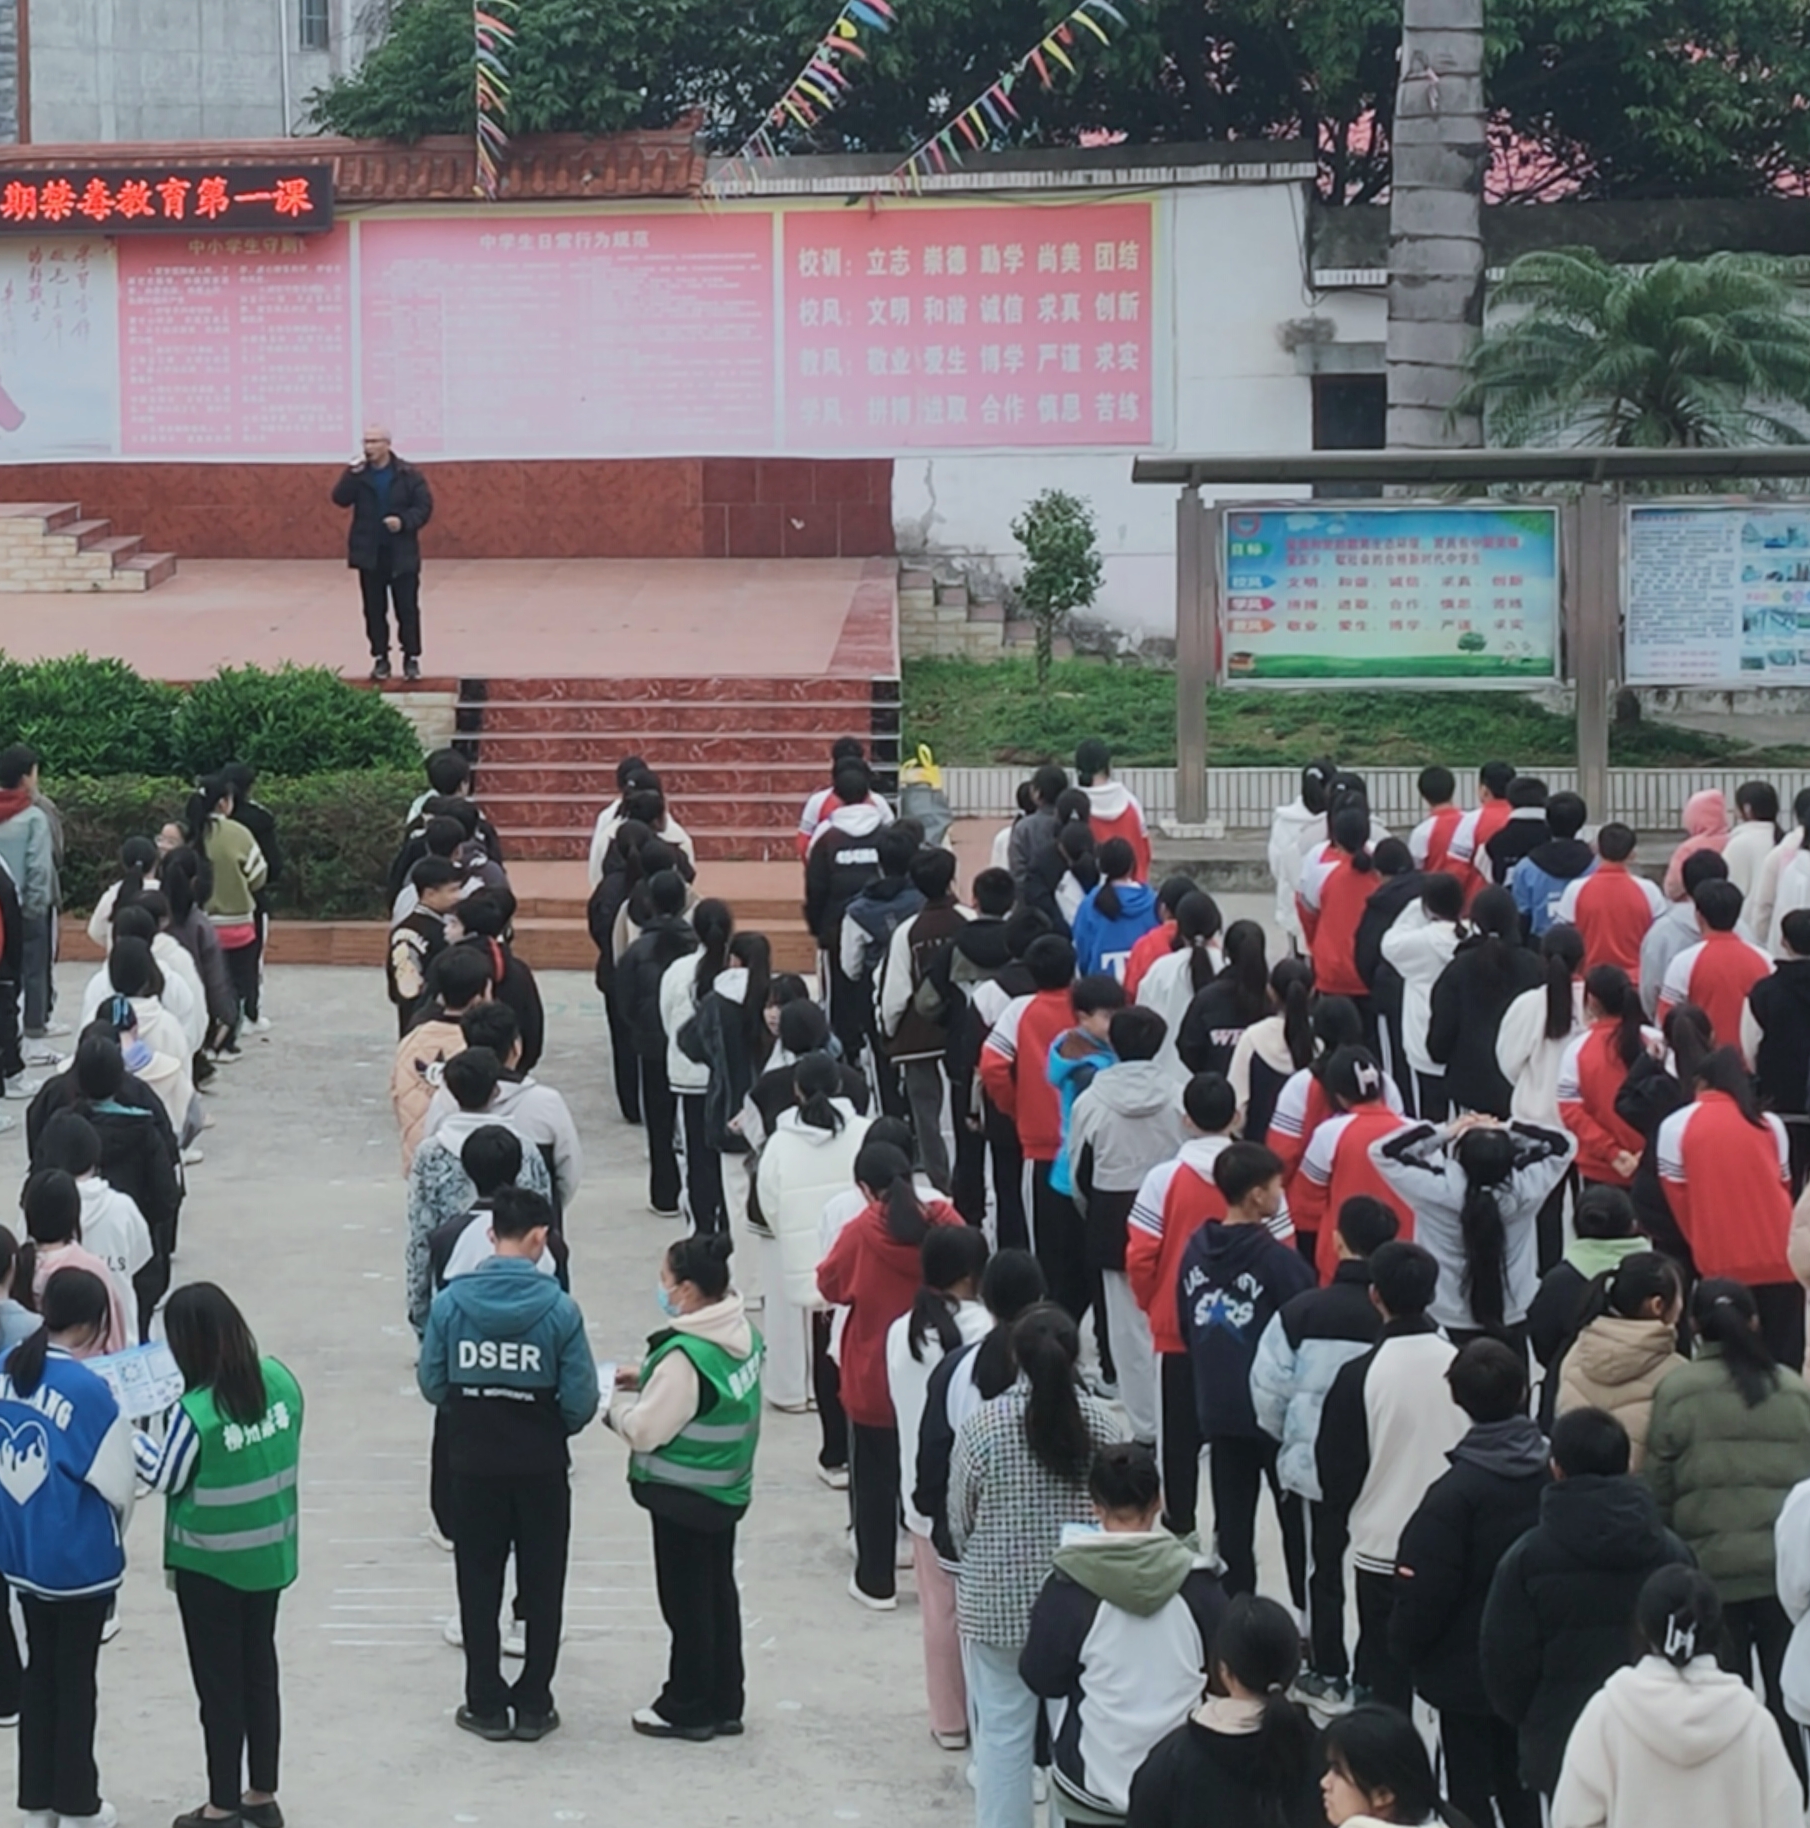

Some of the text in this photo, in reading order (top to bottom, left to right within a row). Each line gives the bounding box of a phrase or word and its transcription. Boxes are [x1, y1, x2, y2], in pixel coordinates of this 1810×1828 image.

[479, 230, 651, 251] 中学生日常行为规范
[867, 245, 911, 277] 立志
[923, 245, 968, 276] 崇德
[980, 243, 1025, 274] 勤学
[1038, 243, 1081, 274] 尚美
[1094, 241, 1140, 272] 团结
[867, 296, 911, 326] 文明
[923, 295, 968, 325] 和谐
[980, 294, 1025, 324] 诚信
[1038, 293, 1081, 323] 求真
[1094, 291, 1140, 321] 创新
[867, 345, 911, 376] 敬业
[923, 344, 968, 376] 爱生
[1038, 343, 1081, 374] 严谨
[1094, 342, 1140, 372] 求实
[923, 394, 968, 424] 进取
[980, 394, 1025, 424] 合作
[1094, 392, 1140, 422] 苦练
[458, 1340, 542, 1372] DSER
